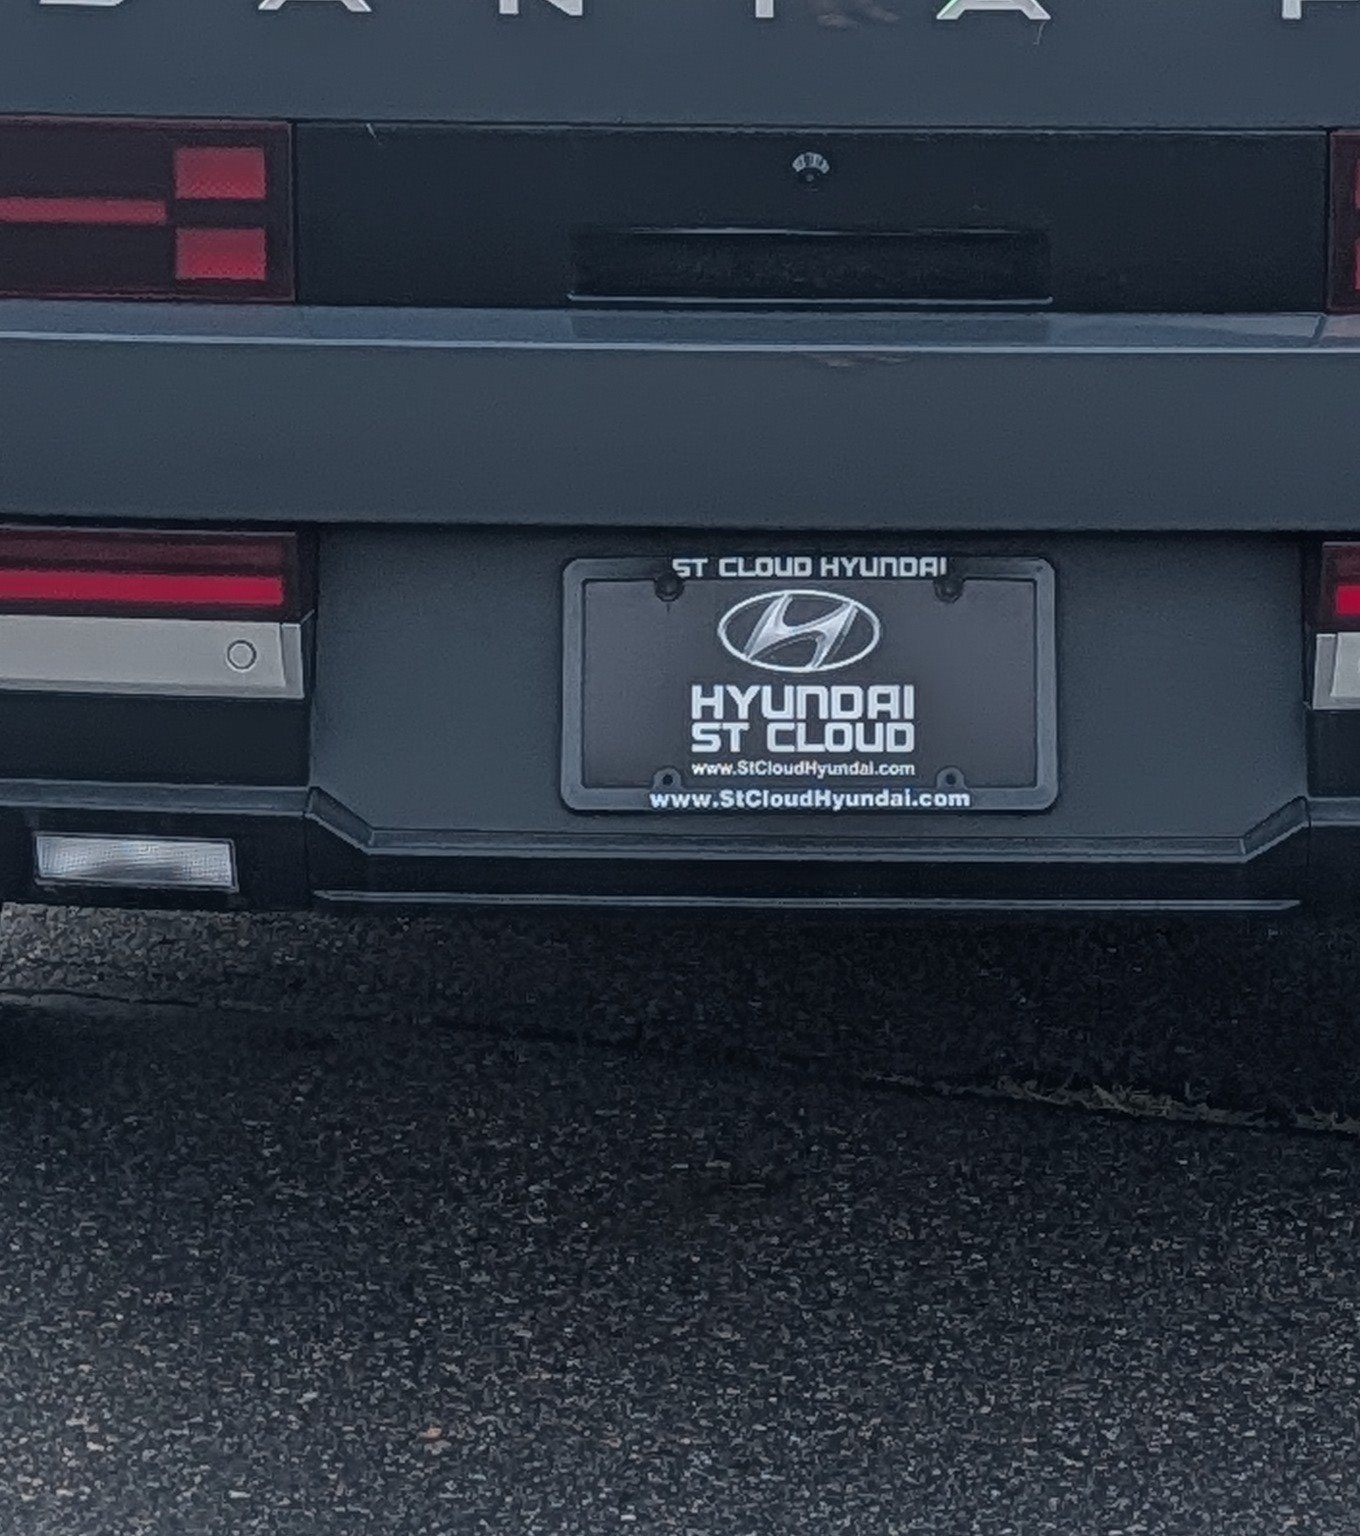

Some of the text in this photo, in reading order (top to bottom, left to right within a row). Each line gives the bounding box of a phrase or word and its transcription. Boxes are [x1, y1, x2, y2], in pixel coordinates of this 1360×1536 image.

[672, 556, 948, 578] ST CLOUD HYUNDAI
[691, 684, 916, 720] HYUNDAI
[691, 722, 916, 753] ST CLOUD
[691, 760, 916, 779] www.StCloudHyundai.com
[648, 788, 971, 811] www.StCloudHyundai.com
